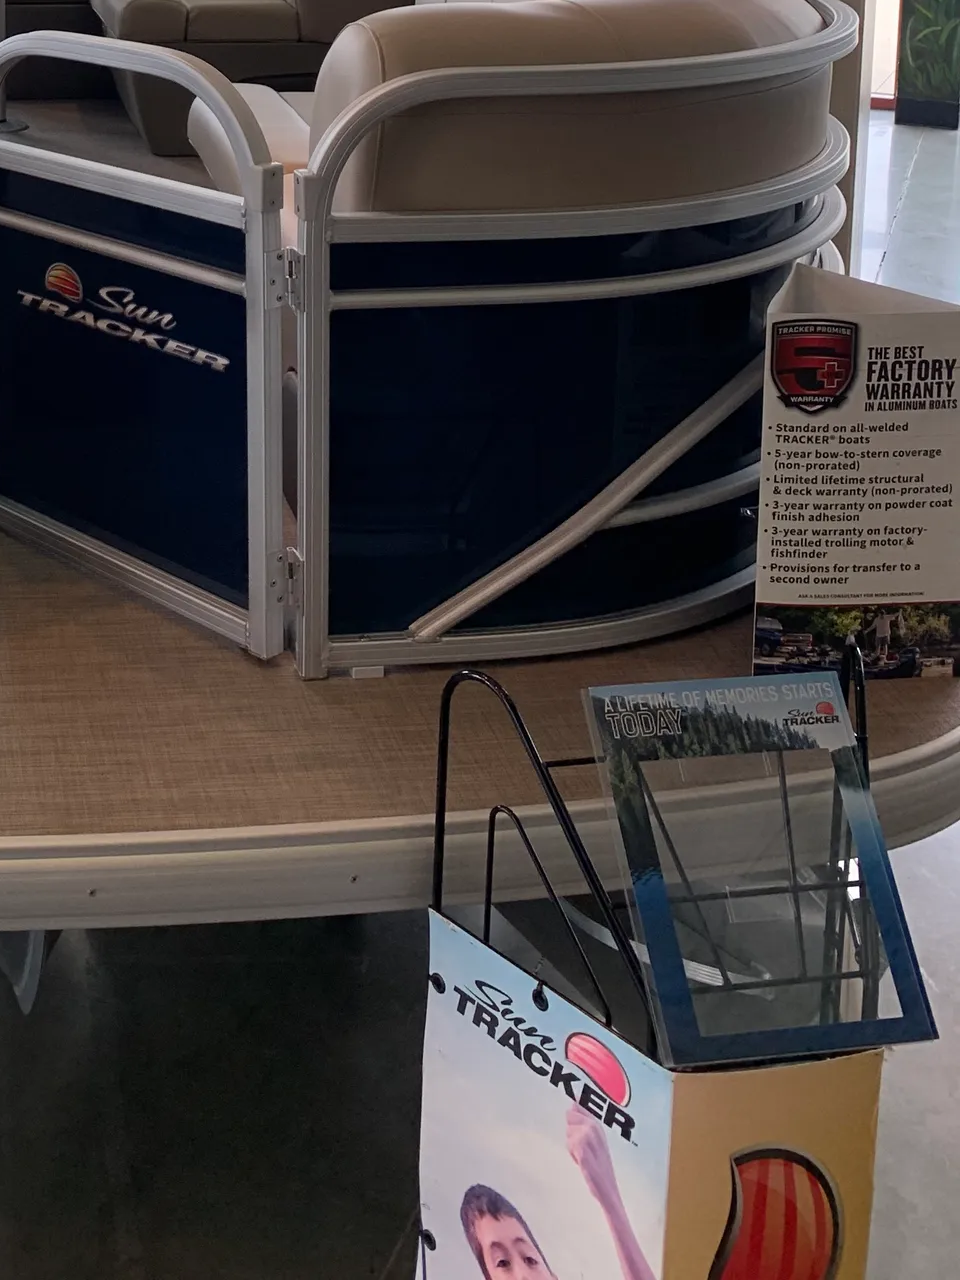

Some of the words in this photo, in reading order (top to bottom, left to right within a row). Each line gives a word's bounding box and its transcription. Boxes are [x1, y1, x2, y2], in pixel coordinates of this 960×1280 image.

[86, 286, 177, 330] Sun
[17, 289, 230, 372] TRACKER
[778, 326, 815, 335] TRACKER
[816, 326, 852, 336] PROMISE
[868, 347, 890, 360] THE
[894, 346, 924, 359] BEST
[867, 358, 957, 382] FACTORY
[866, 381, 955, 400] WARRANTY
[865, 402, 874, 412] IN
[877, 400, 928, 411] ALUMINUM
[929, 399, 958, 410] BOATS
[776, 423, 829, 433] Standard
[833, 425, 847, 433] on
[850, 422, 909, 433] all-welded
[839, 435, 870, 444] boats
[774, 449, 812, 460] 5-year
[815, 449, 889, 459] bow-to-stern
[893, 448, 942, 459] coverage
[774, 460, 860, 472] (non-prorated)
[773, 474, 818, 484] Limited
[821, 474, 866, 484] lifetime
[868, 473, 924, 484] structural
[773, 486, 782, 495] &
[785, 486, 812, 496] deck
[816, 487, 868, 497] warranty
[871, 484, 953, 497] (non-prorated)
[772, 500, 810, 511] 3-year
[813, 502, 865, 512] warranty
[868, 502, 882, 510] on
[884, 500, 926, 511] powder
[929, 499, 953, 508] coat
[772, 511, 805, 522] finish
[808, 512, 860, 522] adhesion
[771, 526, 808, 537] 3-year
[812, 527, 864, 537] warranty
[867, 528, 881, 536] on
[883, 526, 928, 537] factory-
[771, 537, 821, 547] installed
[825, 538, 867, 549] trolling
[869, 538, 904, 547] motor
[906, 537, 914, 545] &
[771, 548, 828, 559] fishfinder
[770, 563, 830, 573] Provisions
[833, 563, 850, 573] for
[852, 563, 897, 572] transfer
[900, 563, 911, 572] to
[914, 563, 920, 571] a
[769, 574, 810, 585] second
[813, 576, 849, 585] owner
[604, 698, 614, 713] A
[616, 692, 680, 712] LIFETIME
[683, 691, 701, 707] OF
[705, 686, 778, 705] MEMORIES
[781, 682, 834, 700] STARTS
[787, 708, 816, 718] Sun
[605, 708, 683, 739] TODAY
[783, 714, 840, 726] TRACKER
[464, 979, 556, 1051] Sun
